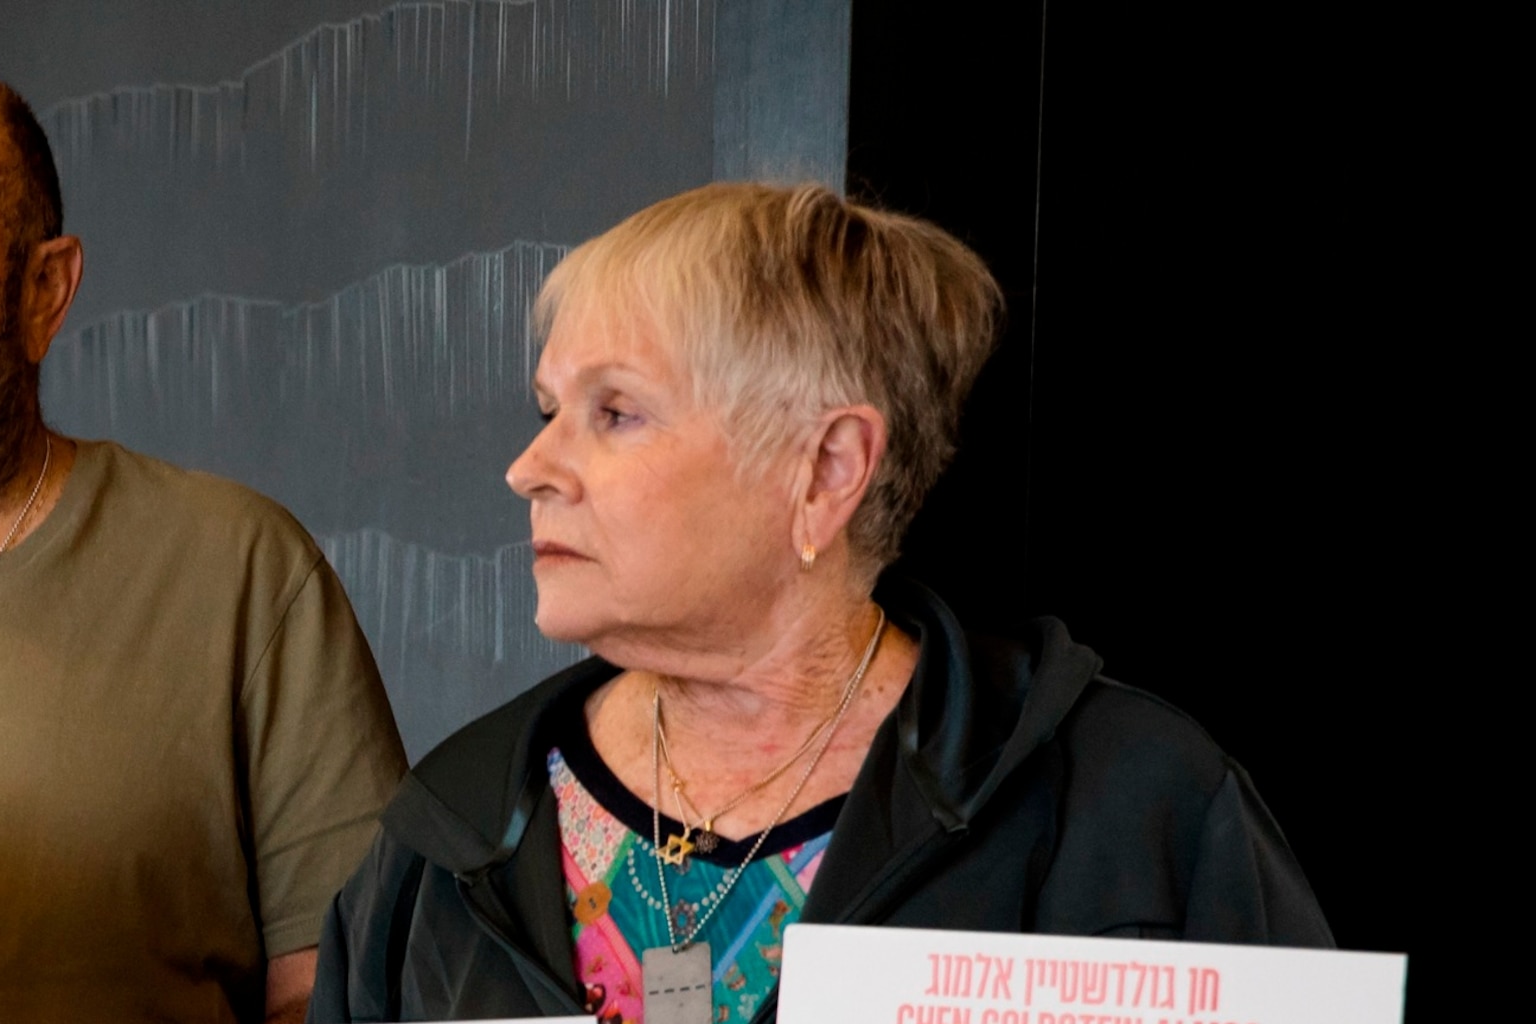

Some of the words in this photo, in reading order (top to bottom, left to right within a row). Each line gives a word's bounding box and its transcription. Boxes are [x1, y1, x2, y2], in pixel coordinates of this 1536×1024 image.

[924, 953, 1012, 1000] אלמוג
[1024, 959, 1175, 1010] גולדשטיין
[1187, 966, 1220, 1015] חן
